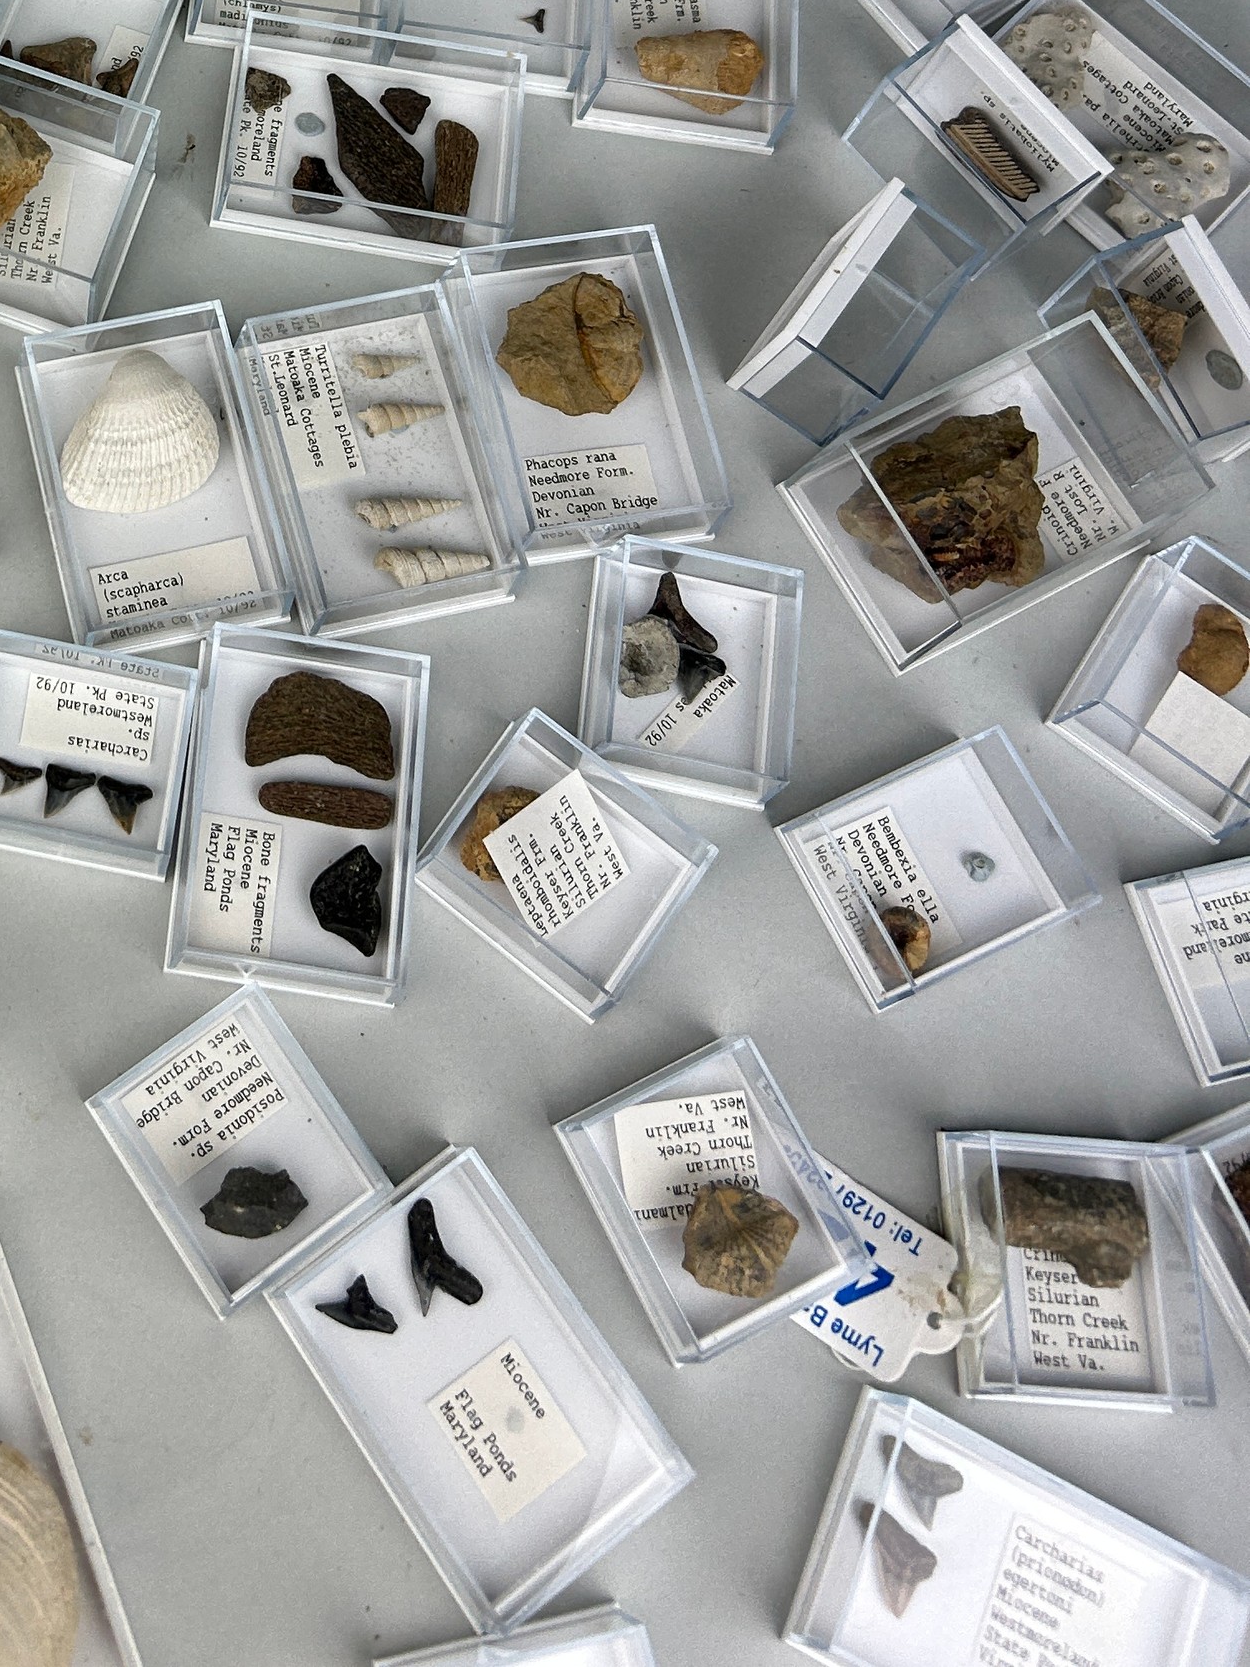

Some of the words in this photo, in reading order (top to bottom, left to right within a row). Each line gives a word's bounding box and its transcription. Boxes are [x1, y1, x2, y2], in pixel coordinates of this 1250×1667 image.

[980, 90, 996, 108] sp.
[1121, 79, 1184, 135] St.Leonard
[1142, 80, 1194, 128] Maryland
[238, 118, 250, 137] Pk.
[998, 111, 1055, 172] Myliobatis
[232, 144, 247, 178] 10/92
[263, 118, 282, 176] fragments
[18, 200, 35, 235] Creek
[30, 195, 51, 251] Franklin
[47, 227, 62, 246] Va.
[267, 353, 299, 427] St.Leonard
[314, 343, 343, 419] Turritella
[333, 423, 359, 469] plebia
[527, 470, 590, 487] Needmore
[595, 466, 633, 478] Form.
[531, 486, 595, 503] Devonian
[1063, 483, 1088, 516] Lost
[1050, 490, 1093, 549] Needmore
[1090, 518, 1107, 542] Nr.
[96, 570, 129, 585] Arca
[103, 571, 183, 603] (scapharca)
[105, 596, 168, 618] staminea
[56, 697, 152, 727] Westmoreland
[692, 674, 737, 718] Matoaka
[127, 726, 150, 741] sp.
[644, 712, 677, 746] 10/92
[67, 735, 148, 761] Carcharias
[203, 821, 222, 892] Maryland
[240, 827, 257, 889] Miocene
[812, 843, 837, 881] West
[846, 828, 887, 897] Devonian
[861, 822, 902, 889] Needmore
[507, 833, 561, 928] rhomboidalis
[549, 843, 586, 908] Silurian
[511, 872, 549, 938] Leptaena
[200, 1053, 262, 1102] Devonian
[212, 1070, 273, 1119] Needmore
[172, 1117, 212, 1146] Form.
[656, 1141, 701, 1156] Creek
[707, 1134, 752, 1151] Thorn
[685, 1153, 755, 1173] Silurian
[888, 1220, 922, 1256] Tel:
[1027, 1287, 1100, 1308] Silurian
[1028, 1307, 1075, 1327] Thorn
[1081, 1312, 1129, 1331] Creek
[830, 1317, 884, 1367] Lyme
[499, 1351, 545, 1419] Miocene
[438, 1399, 493, 1478] Maryland
